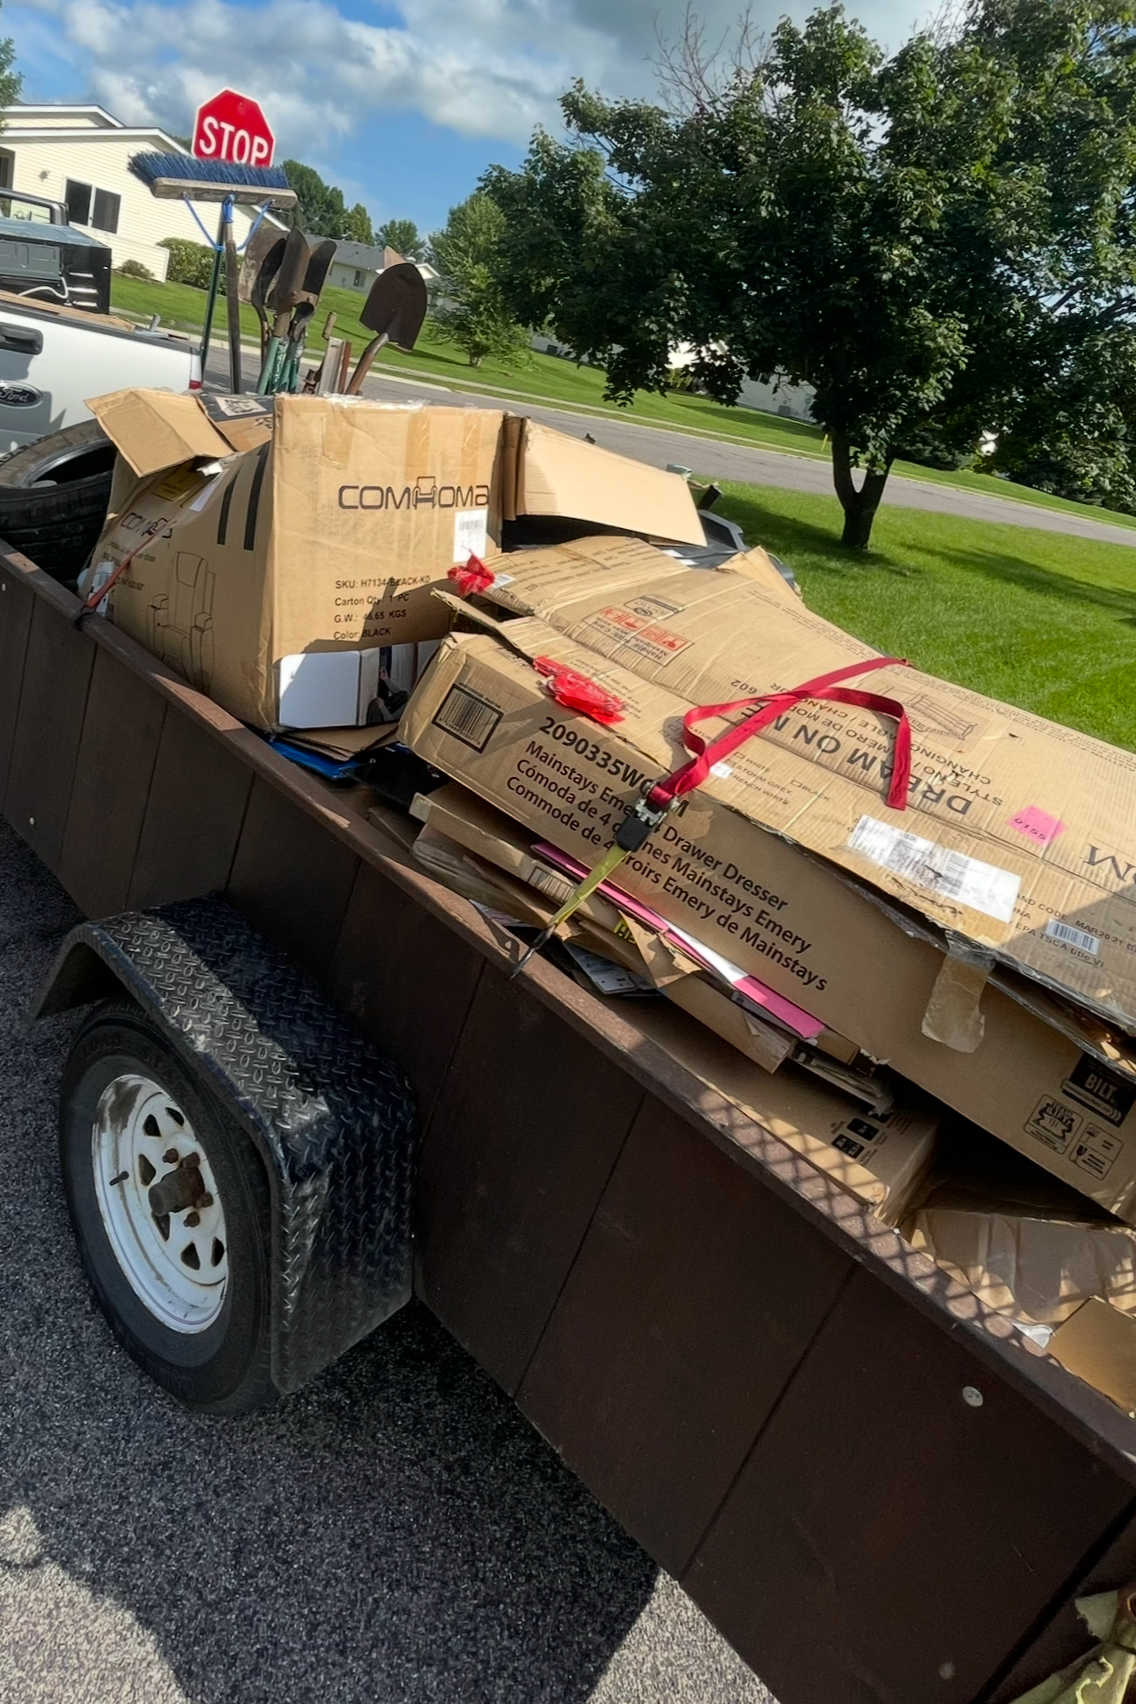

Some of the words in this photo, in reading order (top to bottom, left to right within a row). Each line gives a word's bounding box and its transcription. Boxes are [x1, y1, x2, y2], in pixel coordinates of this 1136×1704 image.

[199, 115, 269, 166] STOP
[0, 387, 29, 402] Ford
[335, 579, 359, 590] SKU:
[335, 596, 365, 607] Carton
[398, 593, 410, 603] PC
[388, 609, 407, 619] KGS
[333, 631, 361, 641] Color:
[362, 626, 392, 638] BLACK
[730, 679, 758, 695] 602
[792, 724, 842, 754] ON
[821, 718, 844, 732] DE
[858, 719, 898, 741] ABLE
[845, 729, 895, 757] MÉRO
[539, 716, 690, 818] 2090335W
[745, 757, 771, 774] WHITE
[911, 742, 992, 785] CHANGING
[735, 764, 767, 783] STORM
[767, 778, 794, 795] GREY
[799, 785, 831, 802] BLACK
[951, 776, 1004, 807] STYLE
[525, 740, 600, 795] Mainstays
[663, 825, 723, 872] Drawer
[722, 862, 788, 912] Dresser
[516, 758, 577, 806] Cómoda
[577, 800, 598, 819] de
[599, 811, 614, 827] 4
[671, 856, 754, 917] Mainstays
[754, 910, 812, 956] Emery
[506, 776, 581, 832] Commode
[581, 827, 602, 846] de
[603, 839, 616, 853] 4
[621, 853, 665, 885] roirs
[662, 876, 717, 920] Emery
[716, 913, 740, 935] de
[739, 926, 829, 992] Mainstays
[1015, 922, 1037, 937] EPA
[1039, 932, 1068, 952] TSCA
[1083, 1072, 1119, 1100] BILT
